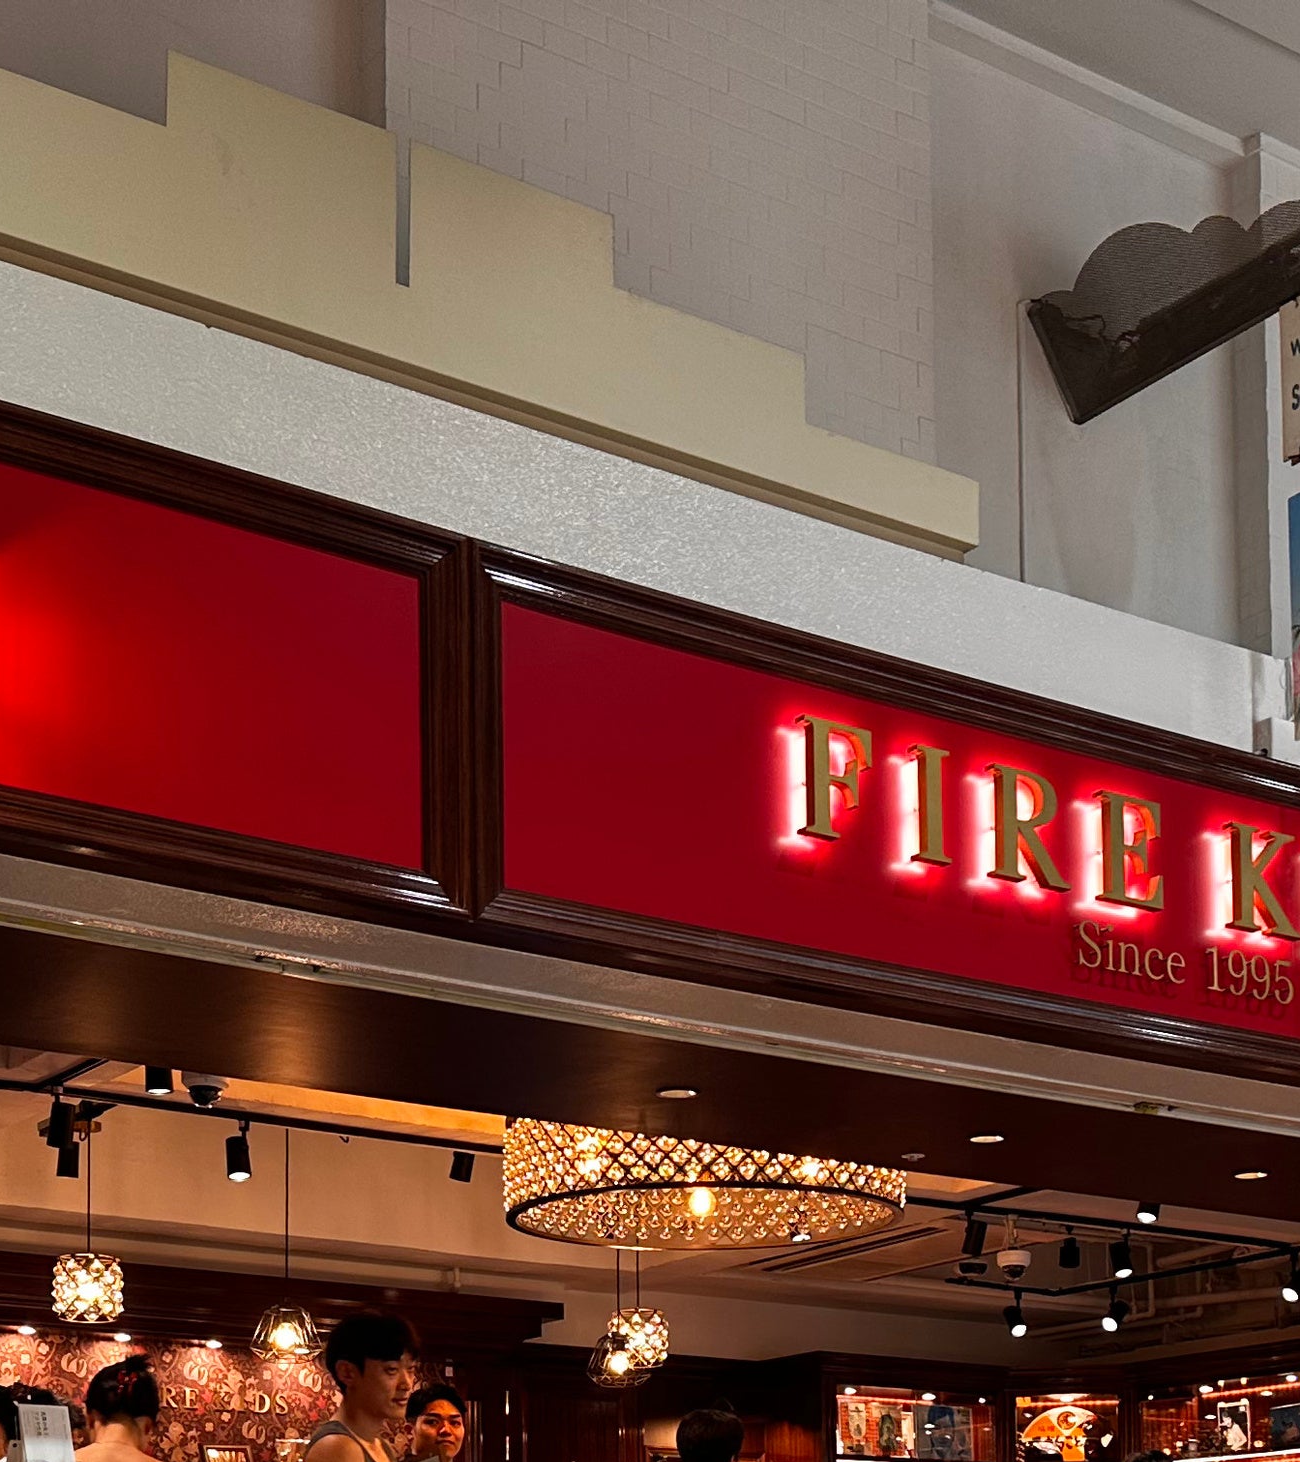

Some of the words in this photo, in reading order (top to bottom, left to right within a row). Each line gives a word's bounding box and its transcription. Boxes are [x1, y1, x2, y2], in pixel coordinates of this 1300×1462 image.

[794, 713, 1166, 912] FIRE
[1076, 919, 1187, 985] Since
[1205, 945, 1297, 1006] 1995
